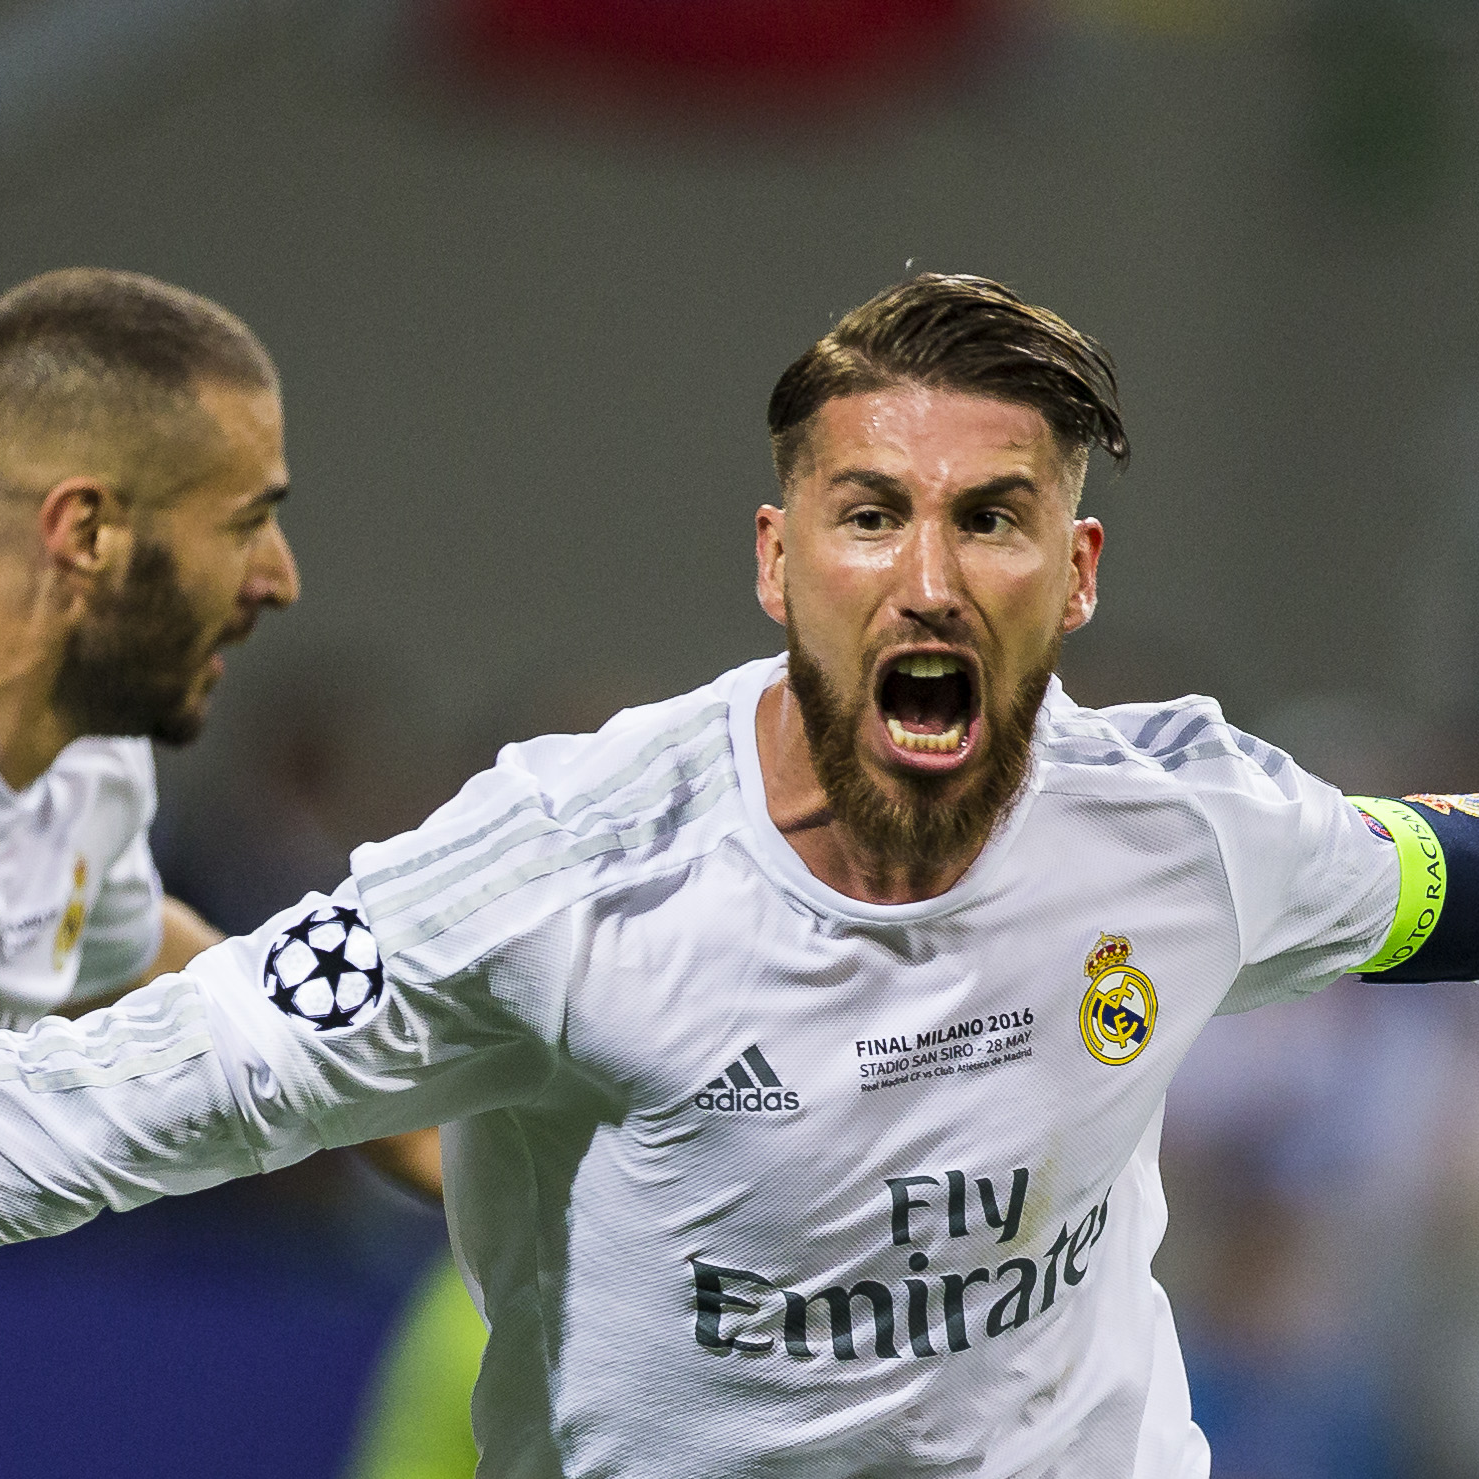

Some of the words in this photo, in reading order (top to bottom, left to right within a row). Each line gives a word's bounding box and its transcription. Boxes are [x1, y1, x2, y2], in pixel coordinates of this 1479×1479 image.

[1374, 945, 1415, 969] NO
[1406, 907, 1436, 942] TO
[855, 1035, 913, 1058] FINAL
[916, 1018, 984, 1050] MILANO
[987, 1007, 1034, 1033] 2016
[859, 1057, 910, 1078] STADIO
[912, 1050, 938, 1068] SAN
[940, 1042, 974, 1061] SIRO
[985, 1038, 1003, 1054] 28
[1005, 1029, 1033, 1049] MAY
[881, 1073, 909, 1089] Madrid
[909, 1071, 922, 1082] CF
[922, 1070, 934, 1079] vs
[933, 1065, 955, 1077] Club
[989, 1056, 1003, 1066] de
[1003, 1046, 1033, 1063] Madrid
[694, 1087, 800, 1113] adidas
[884, 1167, 1030, 1247] Fly
[690, 1184, 1113, 1361] Emirates
